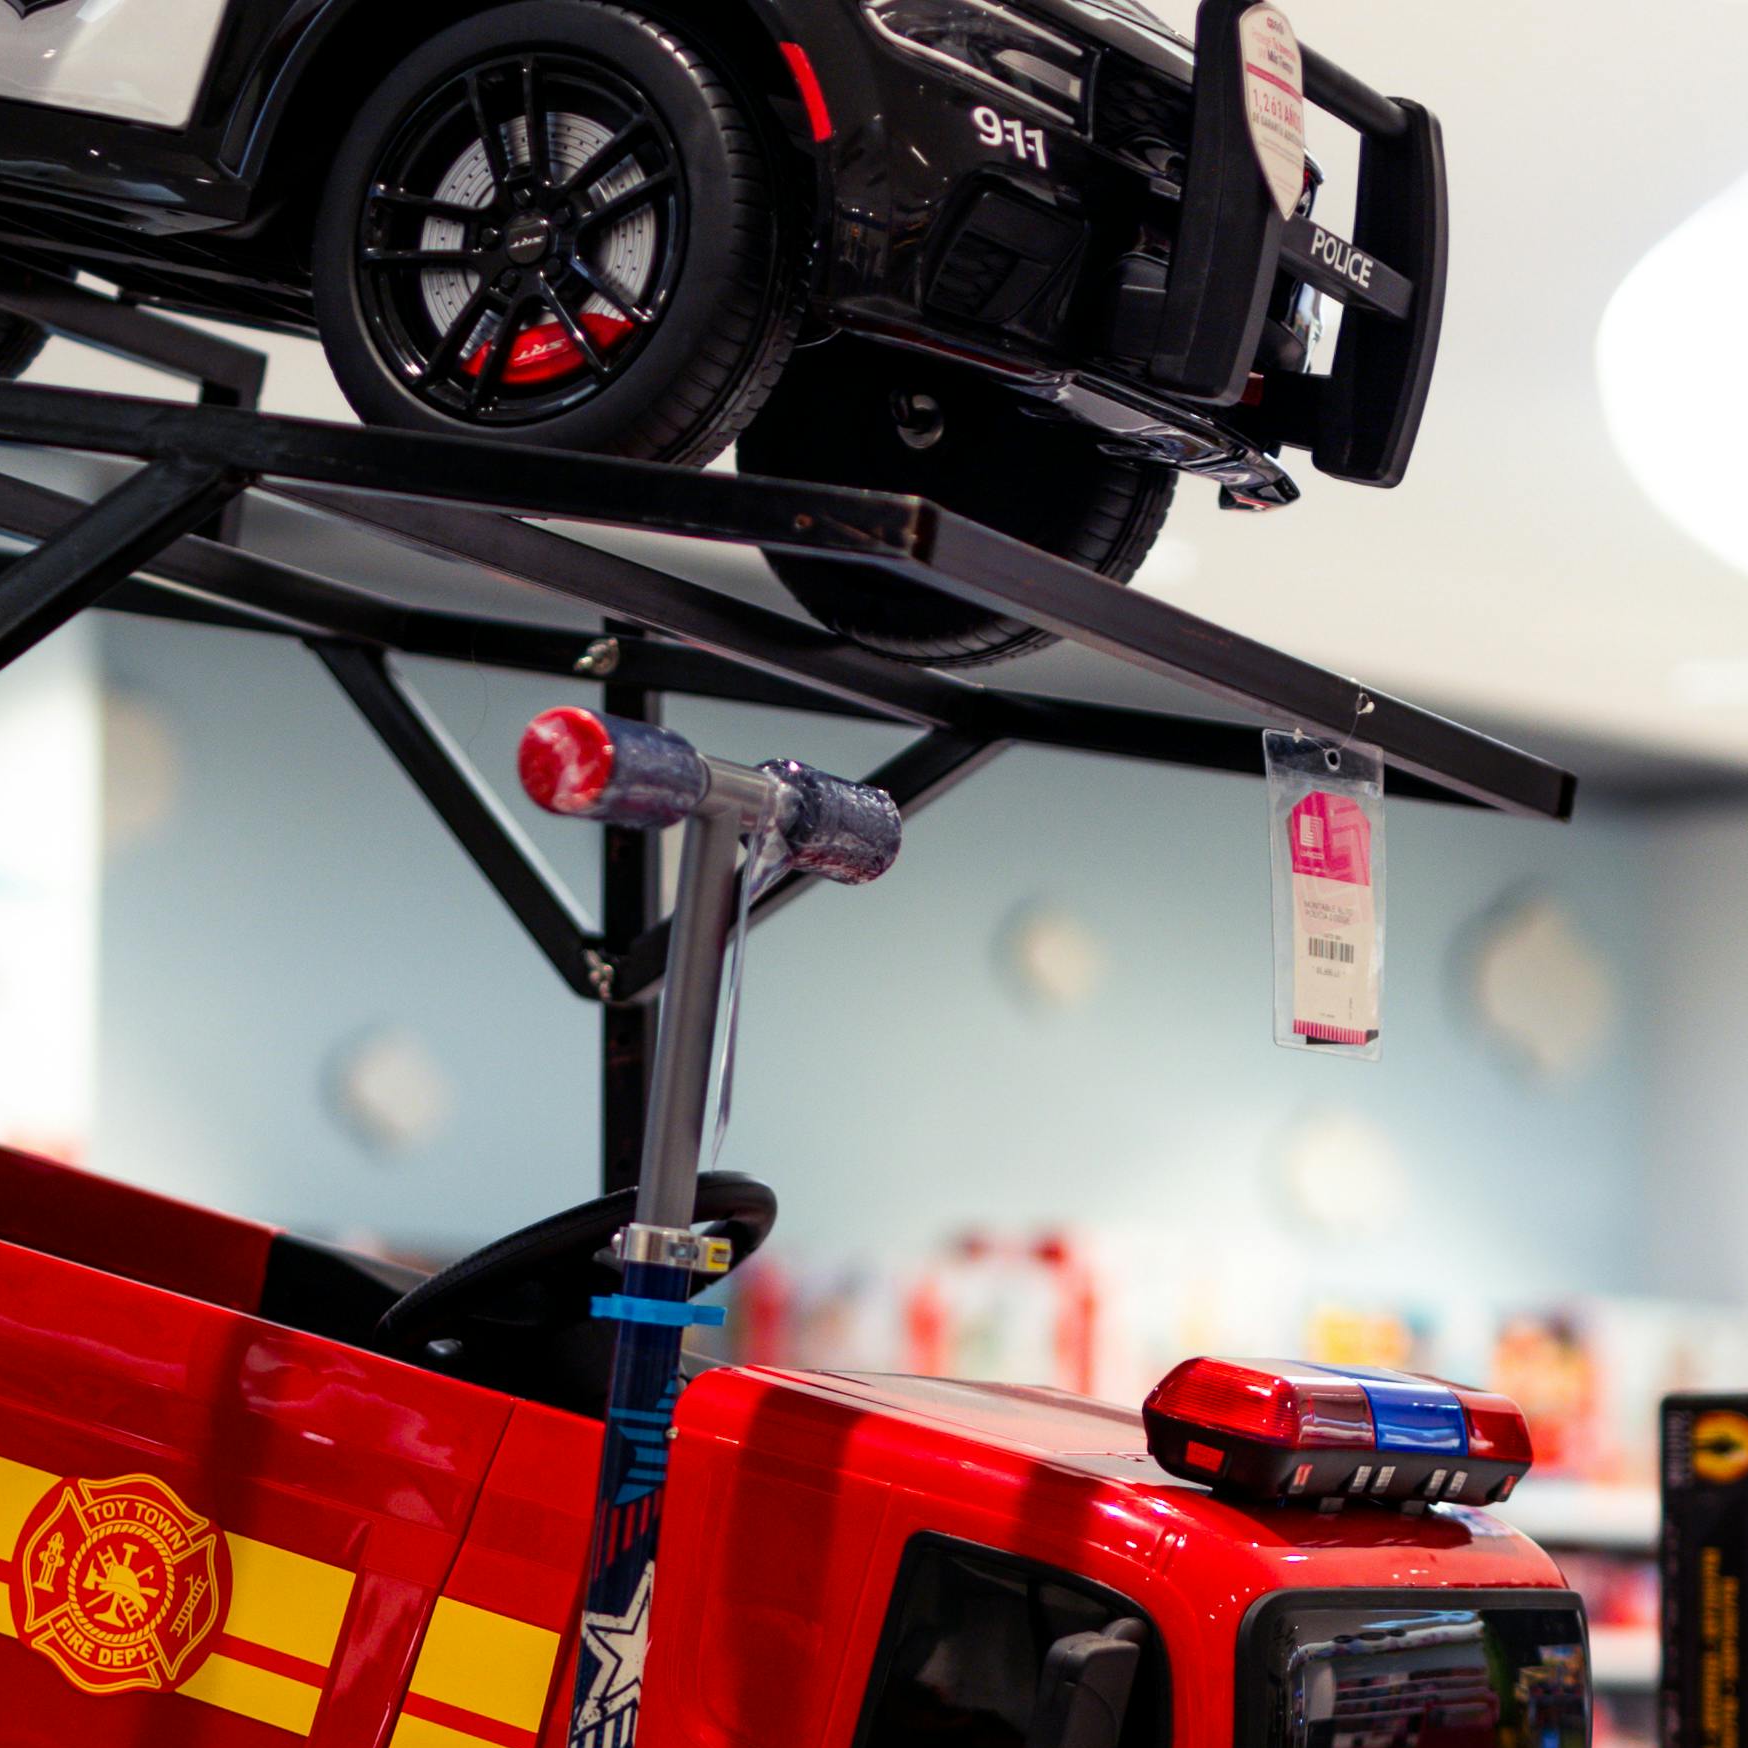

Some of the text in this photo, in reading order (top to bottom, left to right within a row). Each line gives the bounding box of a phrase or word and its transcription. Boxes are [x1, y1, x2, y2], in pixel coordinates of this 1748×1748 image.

[1310, 227, 1374, 289] POLICE
[88, 1501, 186, 1551] TOY TOWN
[55, 1617, 156, 1666] FIRE DEPT.
